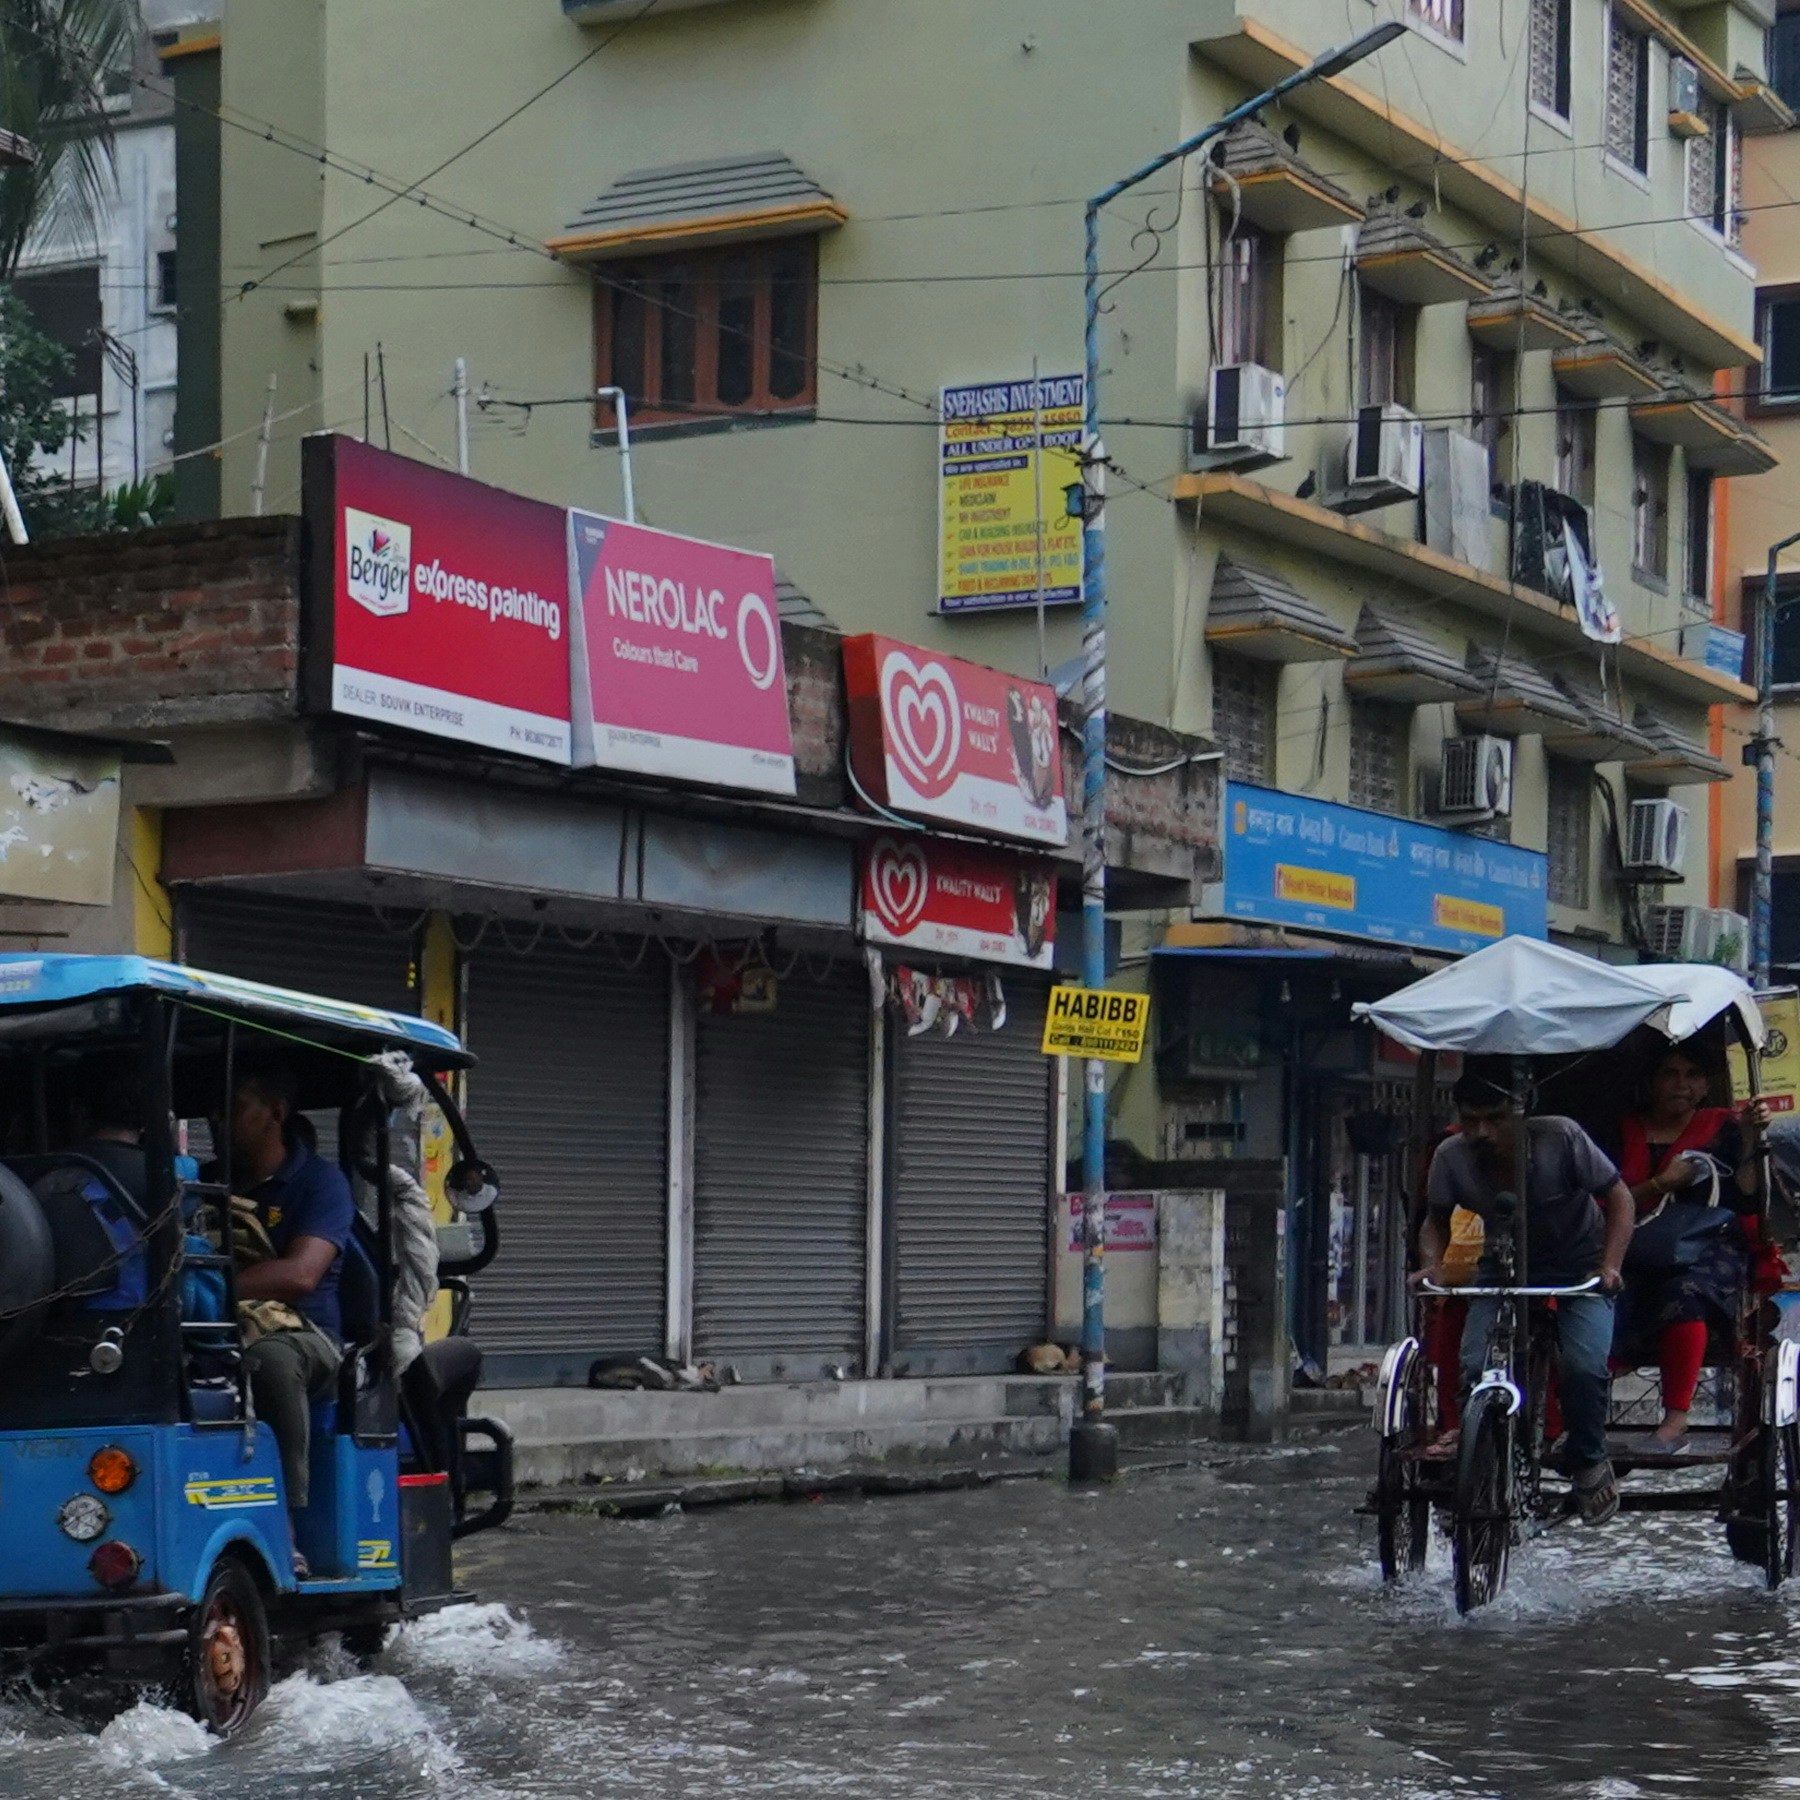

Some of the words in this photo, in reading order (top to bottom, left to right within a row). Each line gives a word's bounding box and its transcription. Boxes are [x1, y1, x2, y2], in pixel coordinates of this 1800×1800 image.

[947, 442, 969, 456] ALL
[1016, 435, 1042, 450] ON
[350, 545, 409, 600] Berger
[415, 559, 488, 612] express
[490, 585, 561, 640] painting
[604, 566, 728, 639] NEROLAC
